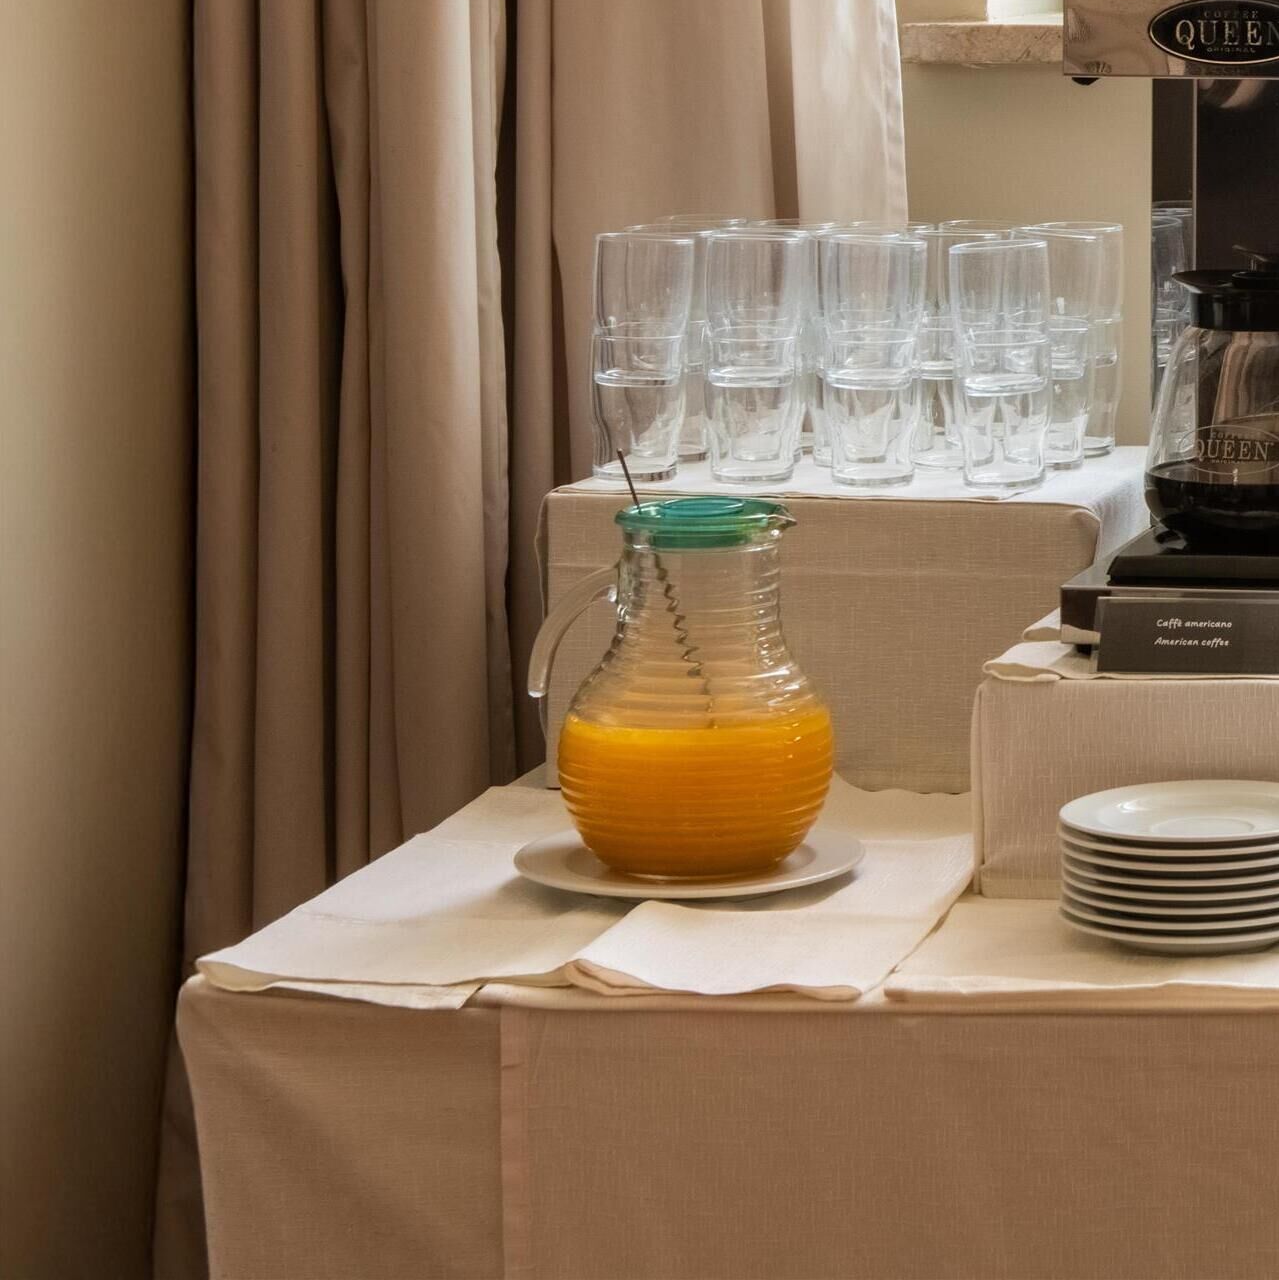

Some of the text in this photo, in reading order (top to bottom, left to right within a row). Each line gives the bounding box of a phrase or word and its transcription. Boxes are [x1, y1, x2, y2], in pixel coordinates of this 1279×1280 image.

[1184, 620, 1232, 628] americano
[1154, 637, 1229, 648] American coffee
